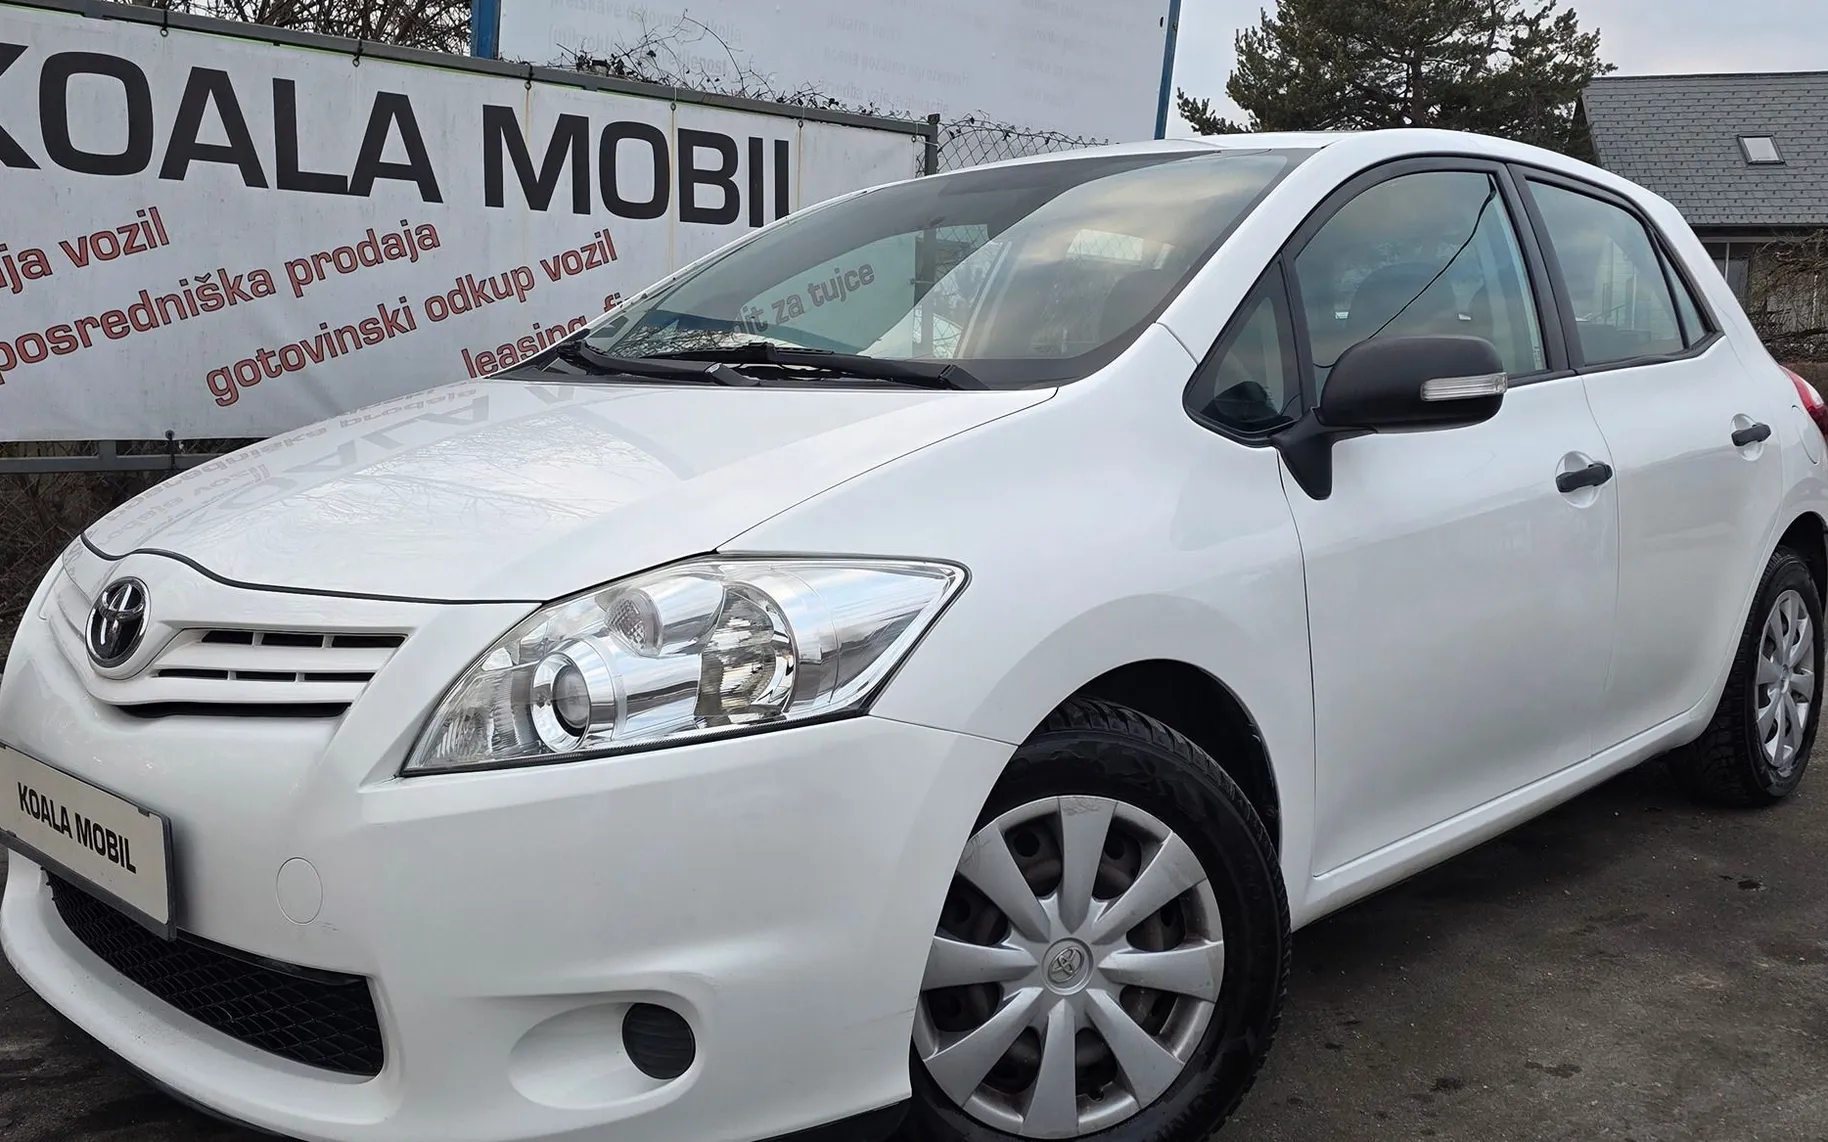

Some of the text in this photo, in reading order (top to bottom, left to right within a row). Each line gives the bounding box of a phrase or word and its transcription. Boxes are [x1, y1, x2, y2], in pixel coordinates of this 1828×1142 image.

[58, 206, 169, 268] vozil
[285, 219, 441, 298] prodaja
[206, 228, 618, 407] gotovinski odkup vozil
[771, 292, 805, 327] za
[807, 263, 875, 307] tujce
[17, 781, 137, 874] KOALA MOBIL
